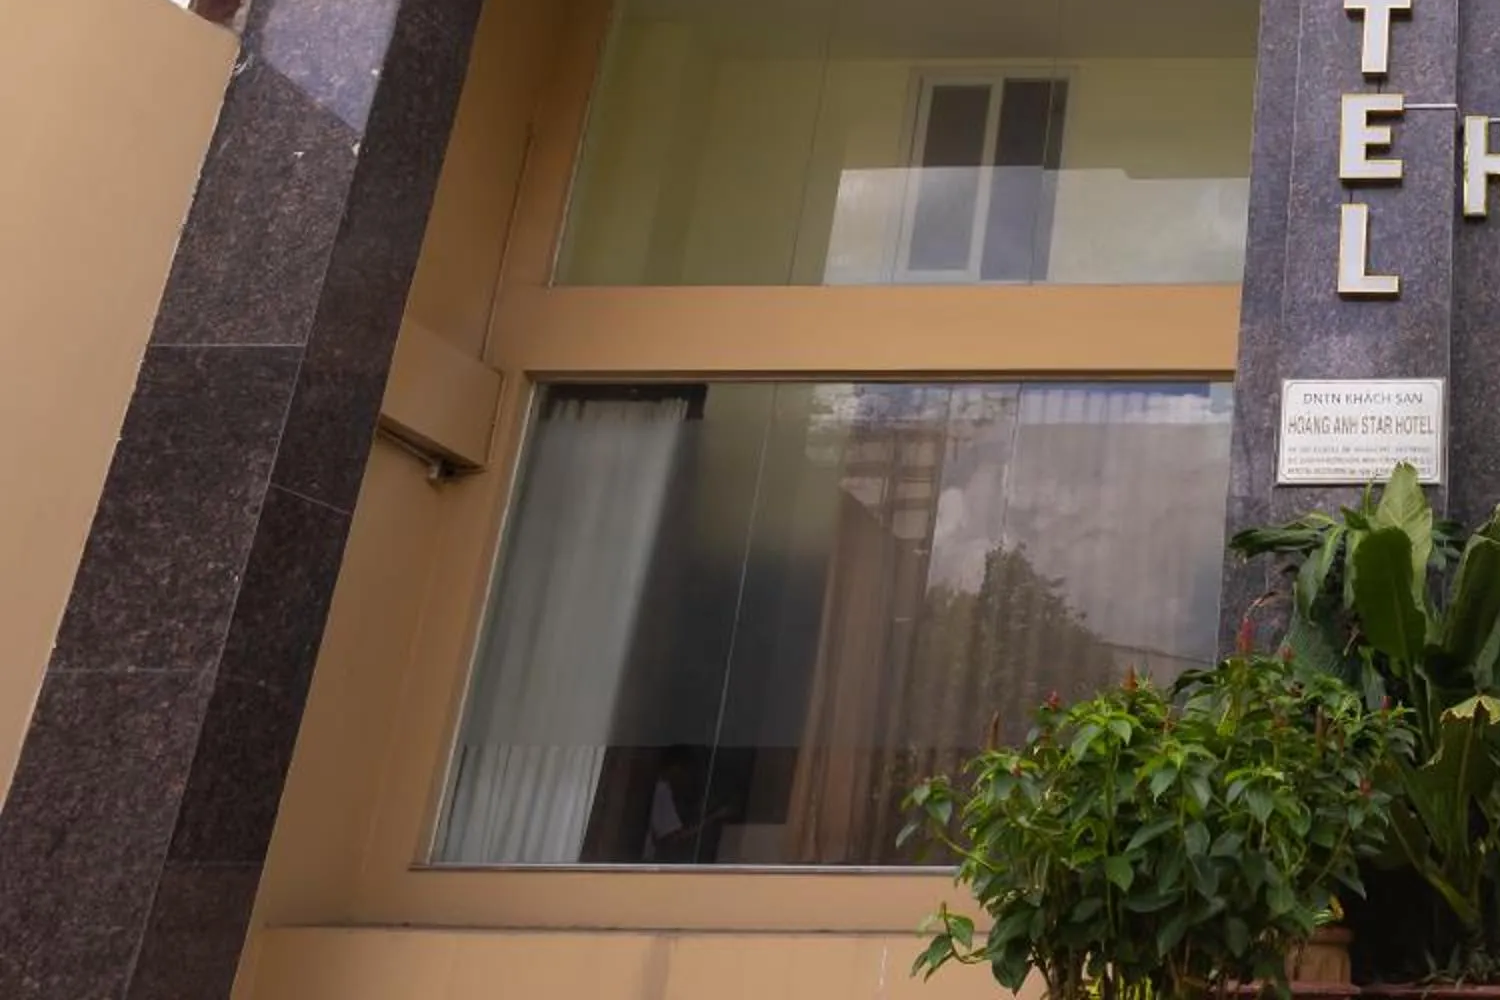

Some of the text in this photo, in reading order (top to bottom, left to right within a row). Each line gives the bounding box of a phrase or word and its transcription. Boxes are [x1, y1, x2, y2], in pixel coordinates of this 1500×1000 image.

[1303, 393, 1341, 405] DNTN
[1333, 415, 1359, 435] ANH
[1361, 415, 1393, 435] STAR
[1395, 415, 1434, 435] HOTEL
